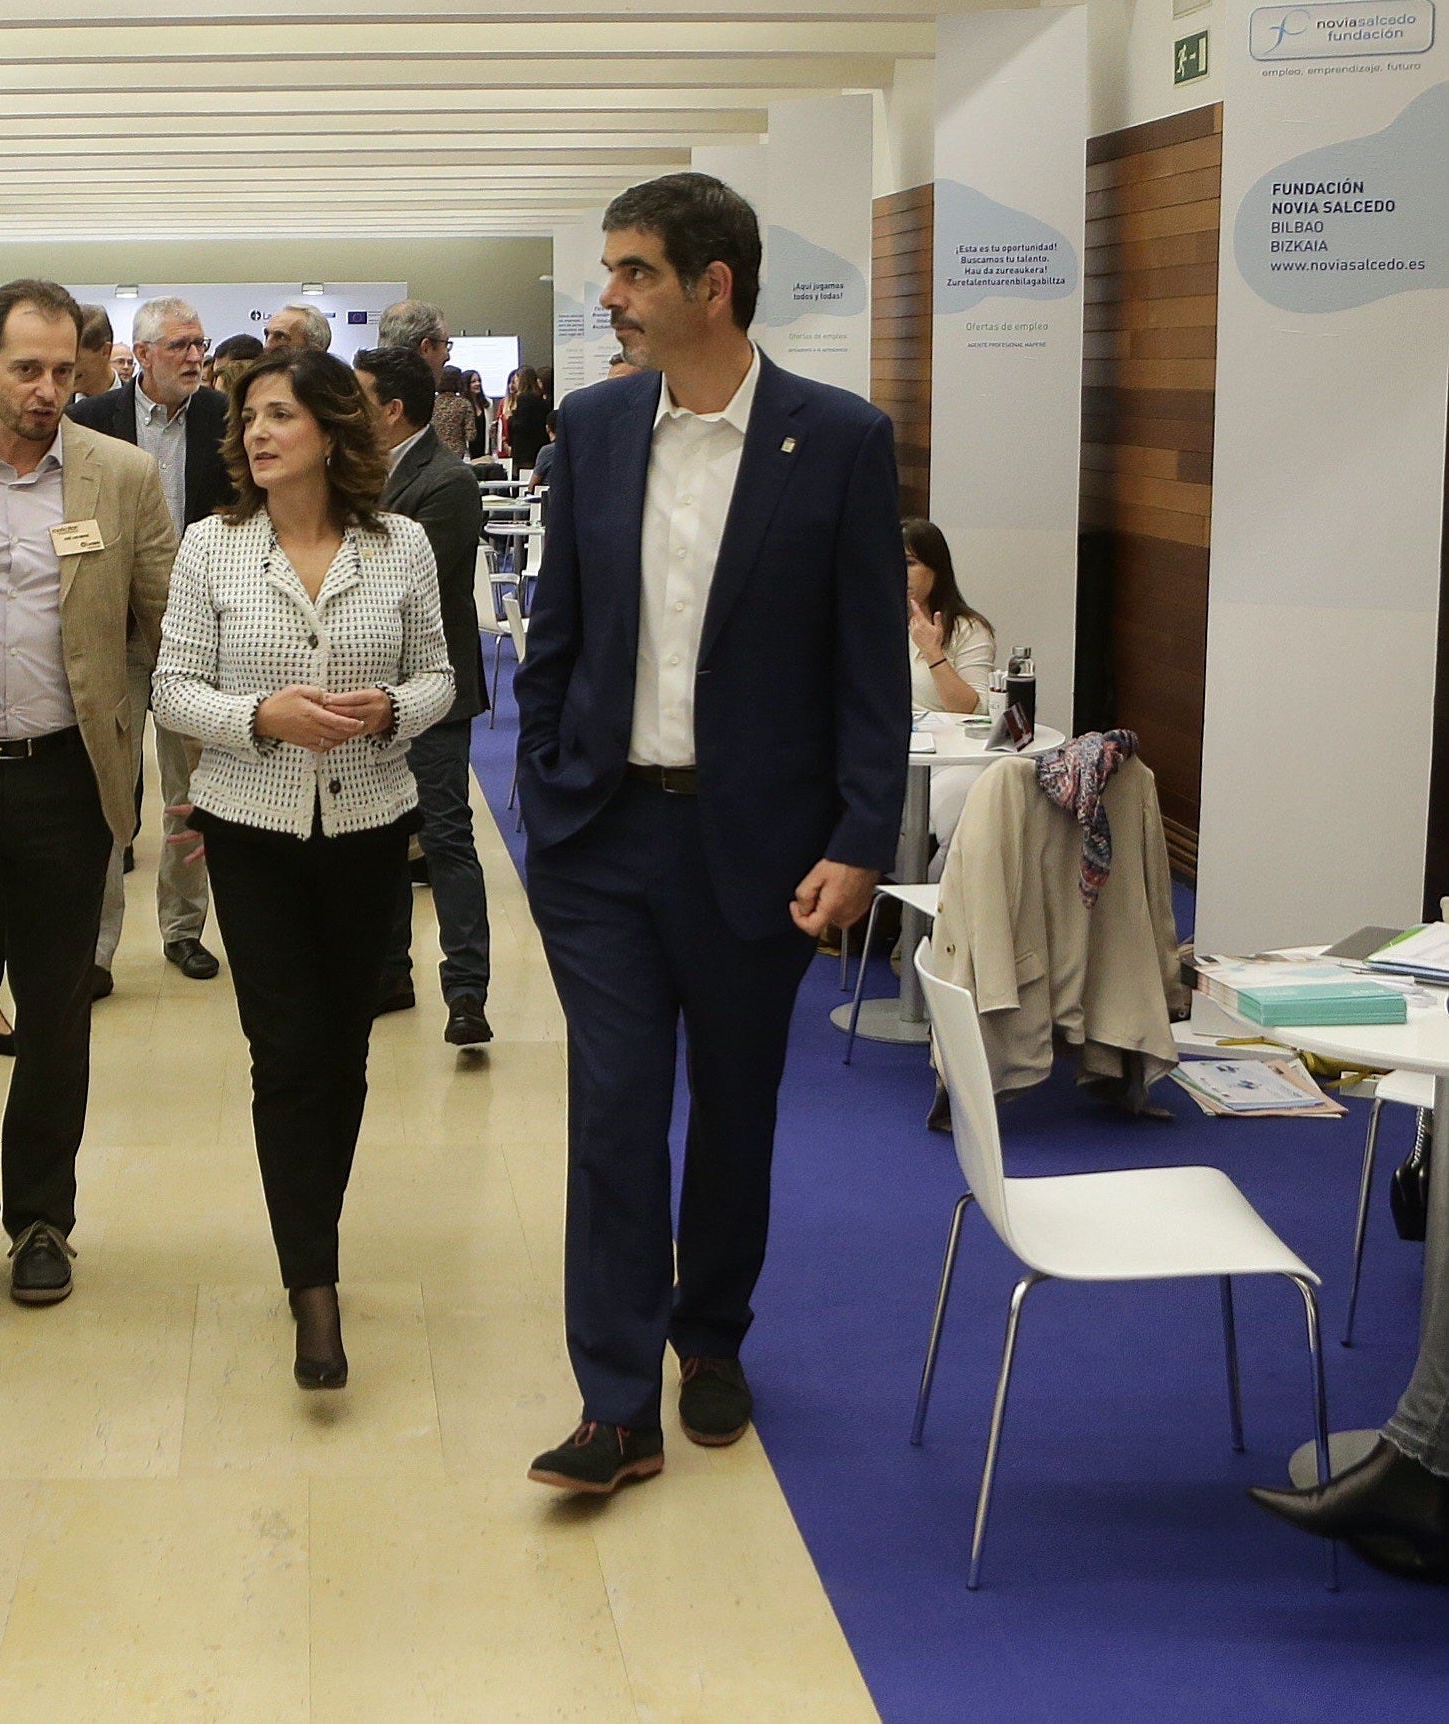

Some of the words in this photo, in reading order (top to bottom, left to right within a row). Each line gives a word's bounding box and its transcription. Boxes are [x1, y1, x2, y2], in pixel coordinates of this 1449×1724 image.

[1316, 14, 1417, 30] noviasalcedo
[1328, 28, 1404, 42] fundación
[1387, 62, 1421, 71] futuro
[1272, 178, 1364, 196] FUNDACIÓN
[1272, 201, 1319, 214] NOVIA
[1323, 200, 1396, 213] SALCEDO
[1271, 221, 1324, 234] BILBAO
[955, 244, 978, 255] ¡Esta
[991, 244, 1000, 252] tu
[1002, 243, 1058, 254] oportunidad!
[1270, 240, 1328, 253] BIZKAIA
[961, 256, 1004, 264] Buscamos
[1017, 255, 1050, 263] talento.
[1270, 259, 1426, 271] www.noviasalcedo.es
[964, 267, 981, 275] Hau
[812, 283, 844, 291] jugamos
[965, 322, 999, 331] Ofertas
[1000, 322, 1013, 331] de
[1014, 321, 1049, 332] empleo
